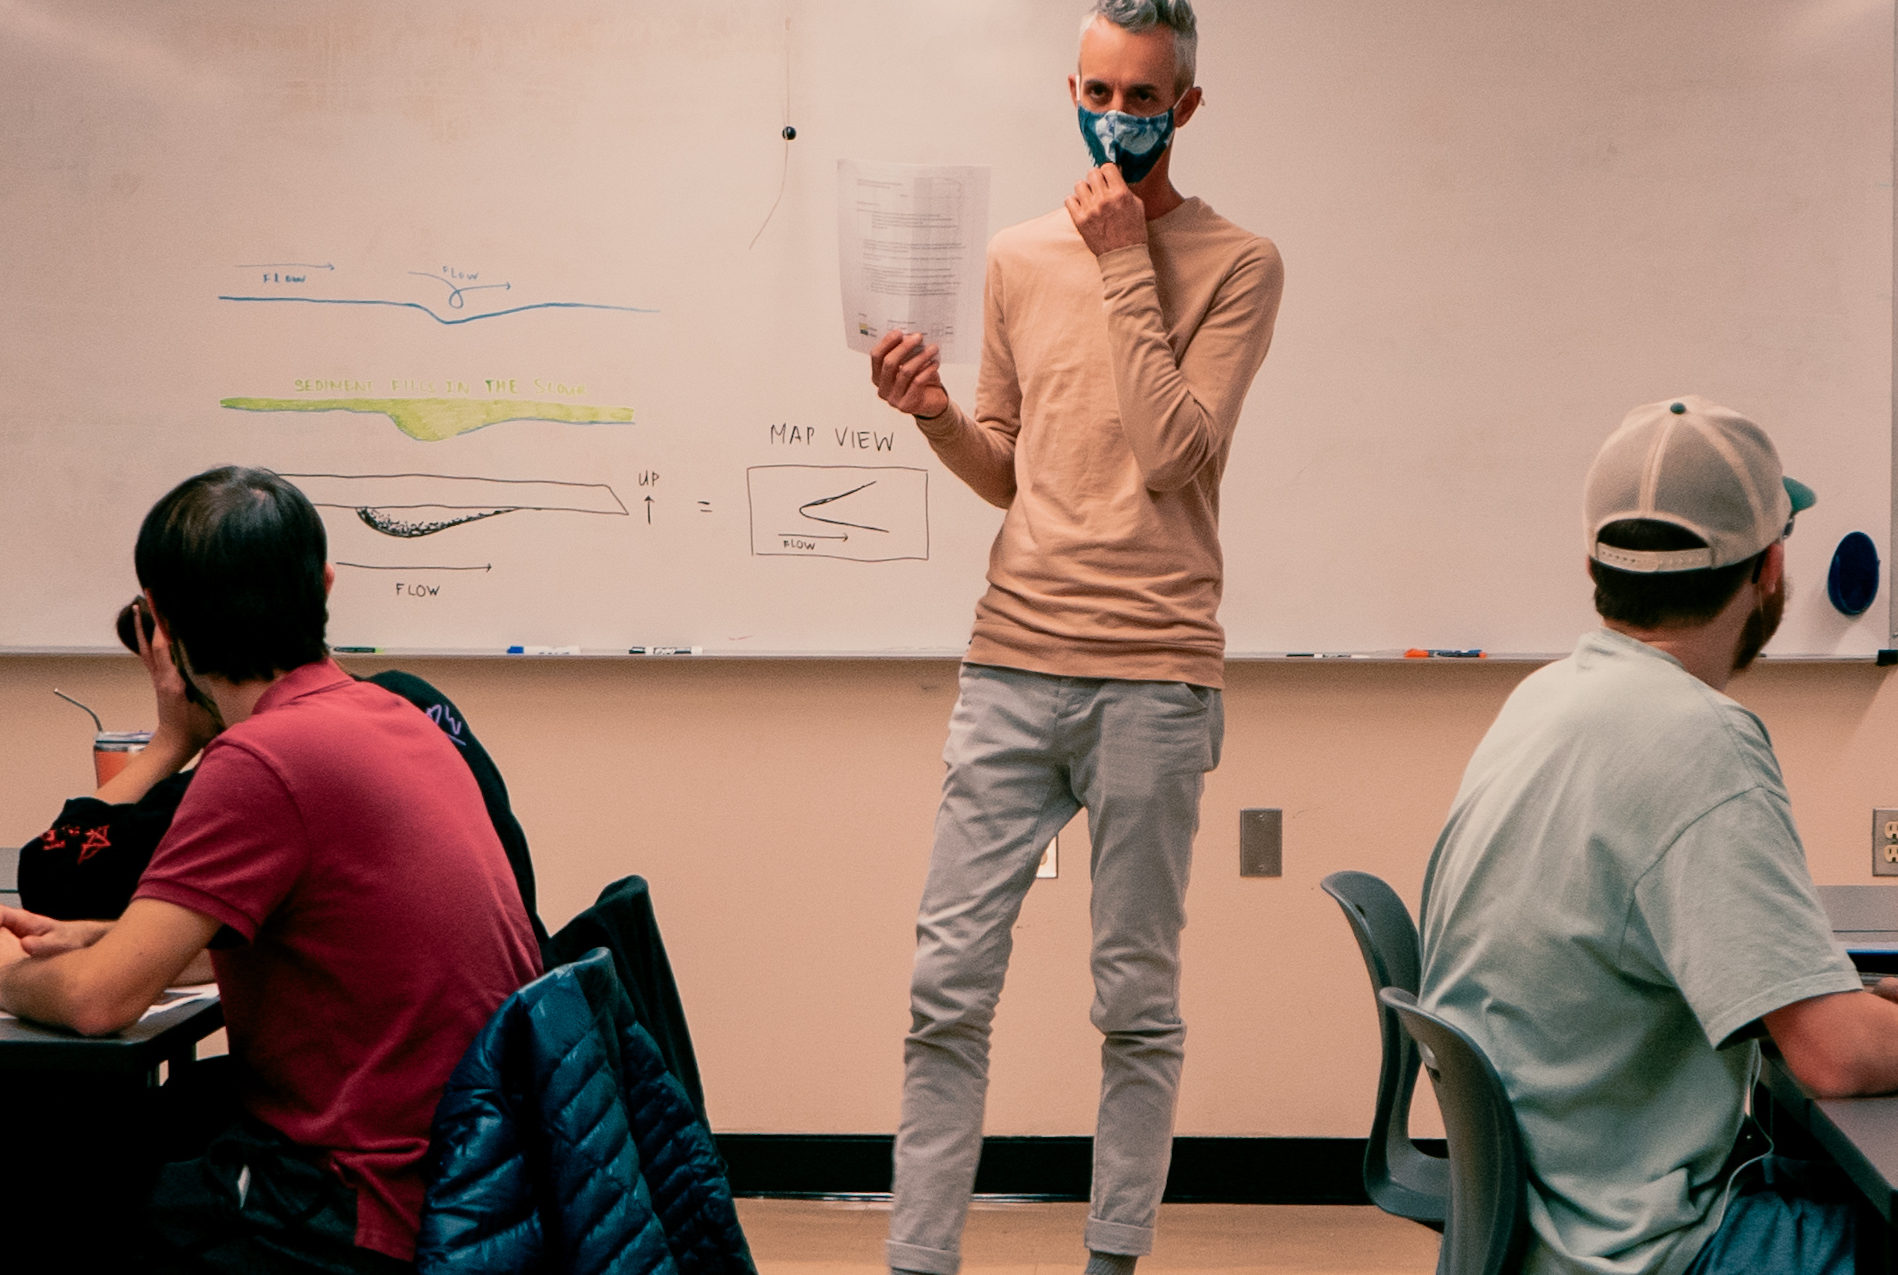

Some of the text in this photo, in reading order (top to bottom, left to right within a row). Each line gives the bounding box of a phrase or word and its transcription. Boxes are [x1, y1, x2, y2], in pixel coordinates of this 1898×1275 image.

[294, 378, 373, 393] SEDIMENT
[445, 379, 471, 395] IN
[484, 378, 519, 395] THE
[769, 422, 896, 453] MAP VIEW
[638, 469, 660, 489] UP
[783, 539, 816, 550] FLOW
[395, 582, 441, 598] FLOW
